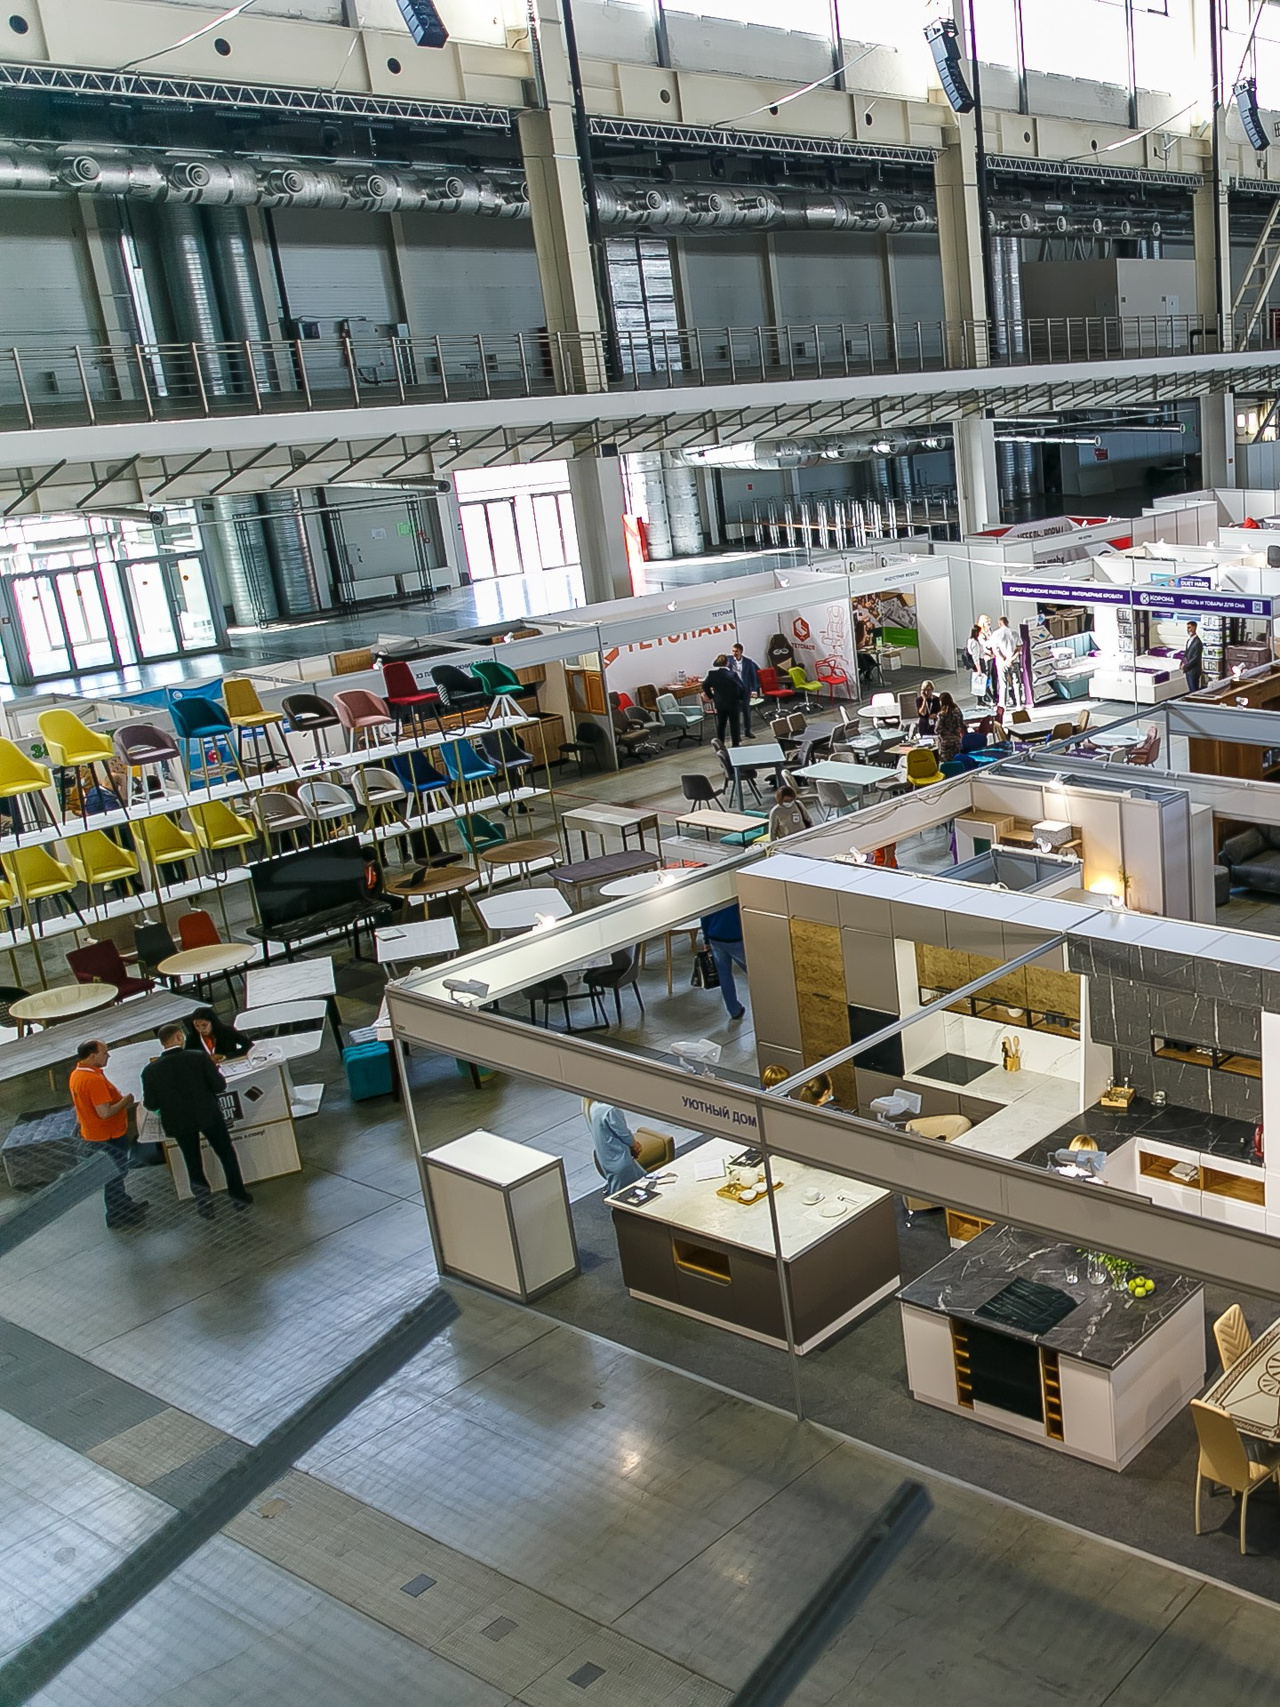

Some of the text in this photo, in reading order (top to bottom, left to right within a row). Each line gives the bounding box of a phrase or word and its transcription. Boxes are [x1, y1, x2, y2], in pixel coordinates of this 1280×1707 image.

[1150, 595, 1174, 603] КОРОНА
[712, 609, 733, 618] TETCHAIR
[681, 1095, 757, 1128] УЮТНЫЙ ДОМ
